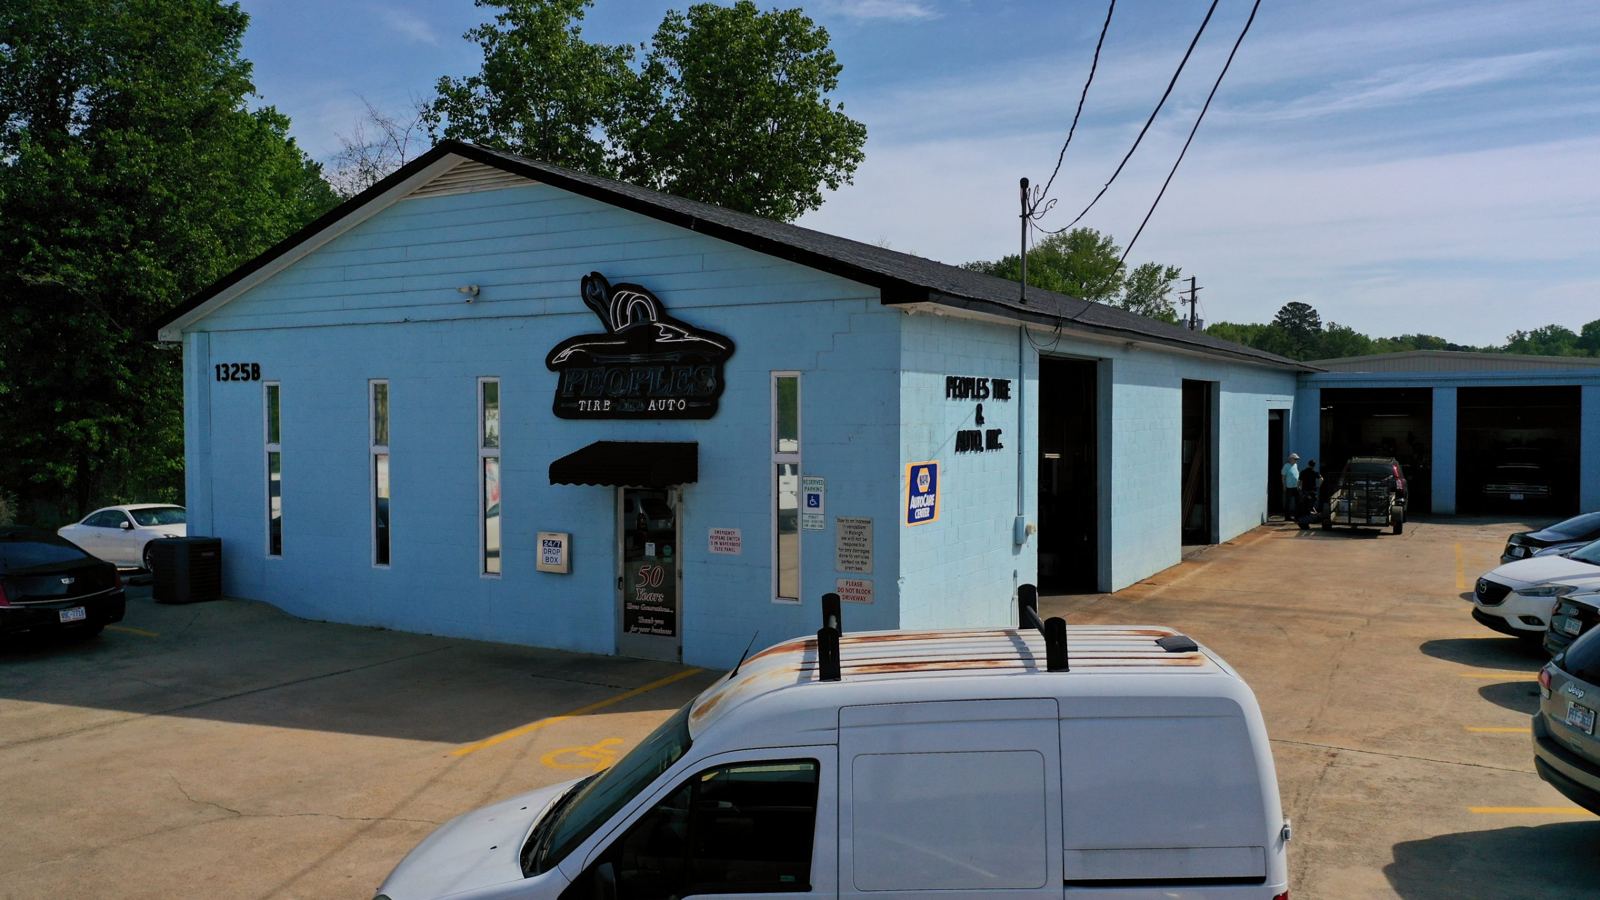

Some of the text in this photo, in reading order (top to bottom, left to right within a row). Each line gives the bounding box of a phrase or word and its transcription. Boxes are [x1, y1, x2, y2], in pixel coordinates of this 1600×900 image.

[215, 363, 261, 382] 1325B
[578, 400, 611, 411] TIRE
[648, 399, 687, 411] AUTO
[635, 565, 665, 588] 50
[635, 587, 665, 602] Years
[1568, 684, 1585, 699] Jeep
